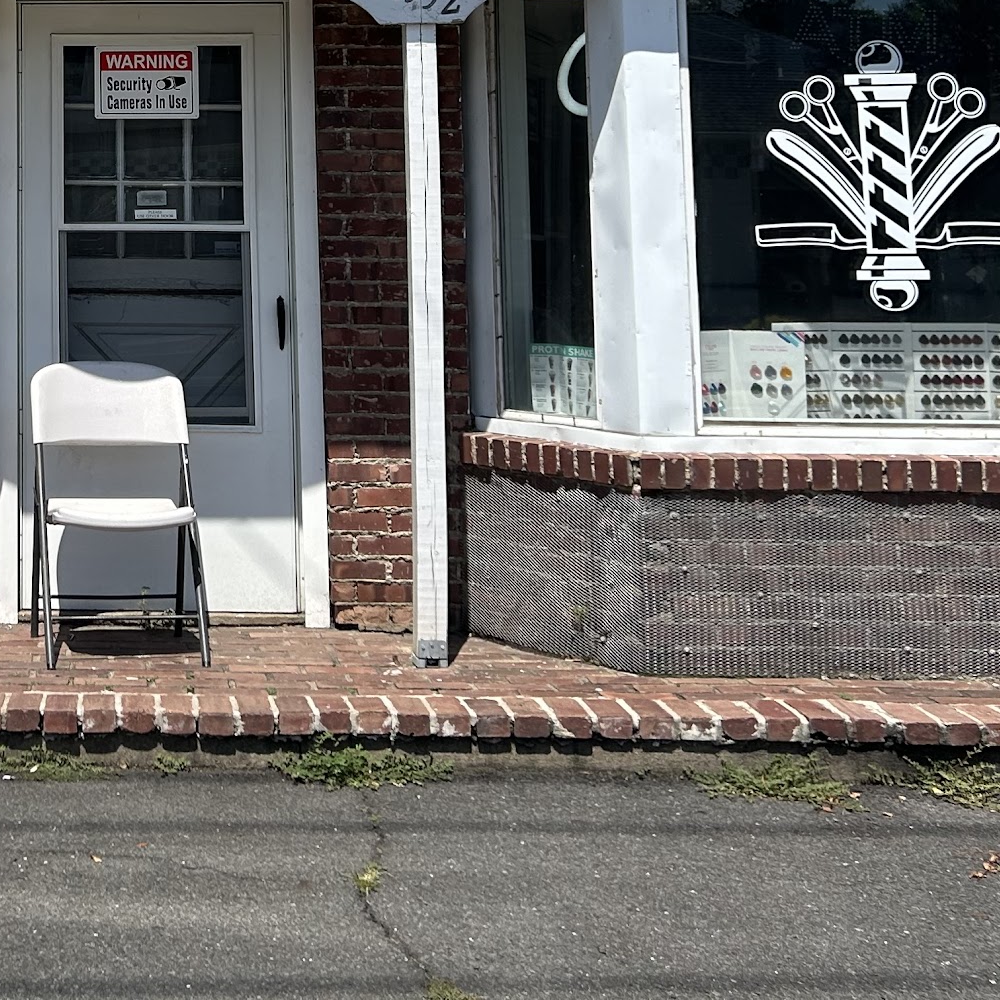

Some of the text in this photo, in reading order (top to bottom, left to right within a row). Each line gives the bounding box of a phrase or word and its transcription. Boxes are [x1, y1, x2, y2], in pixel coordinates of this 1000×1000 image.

[105, 54, 189, 70] WARNING
[106, 76, 152, 94] Security
[107, 95, 187, 110] Cameras In Use
